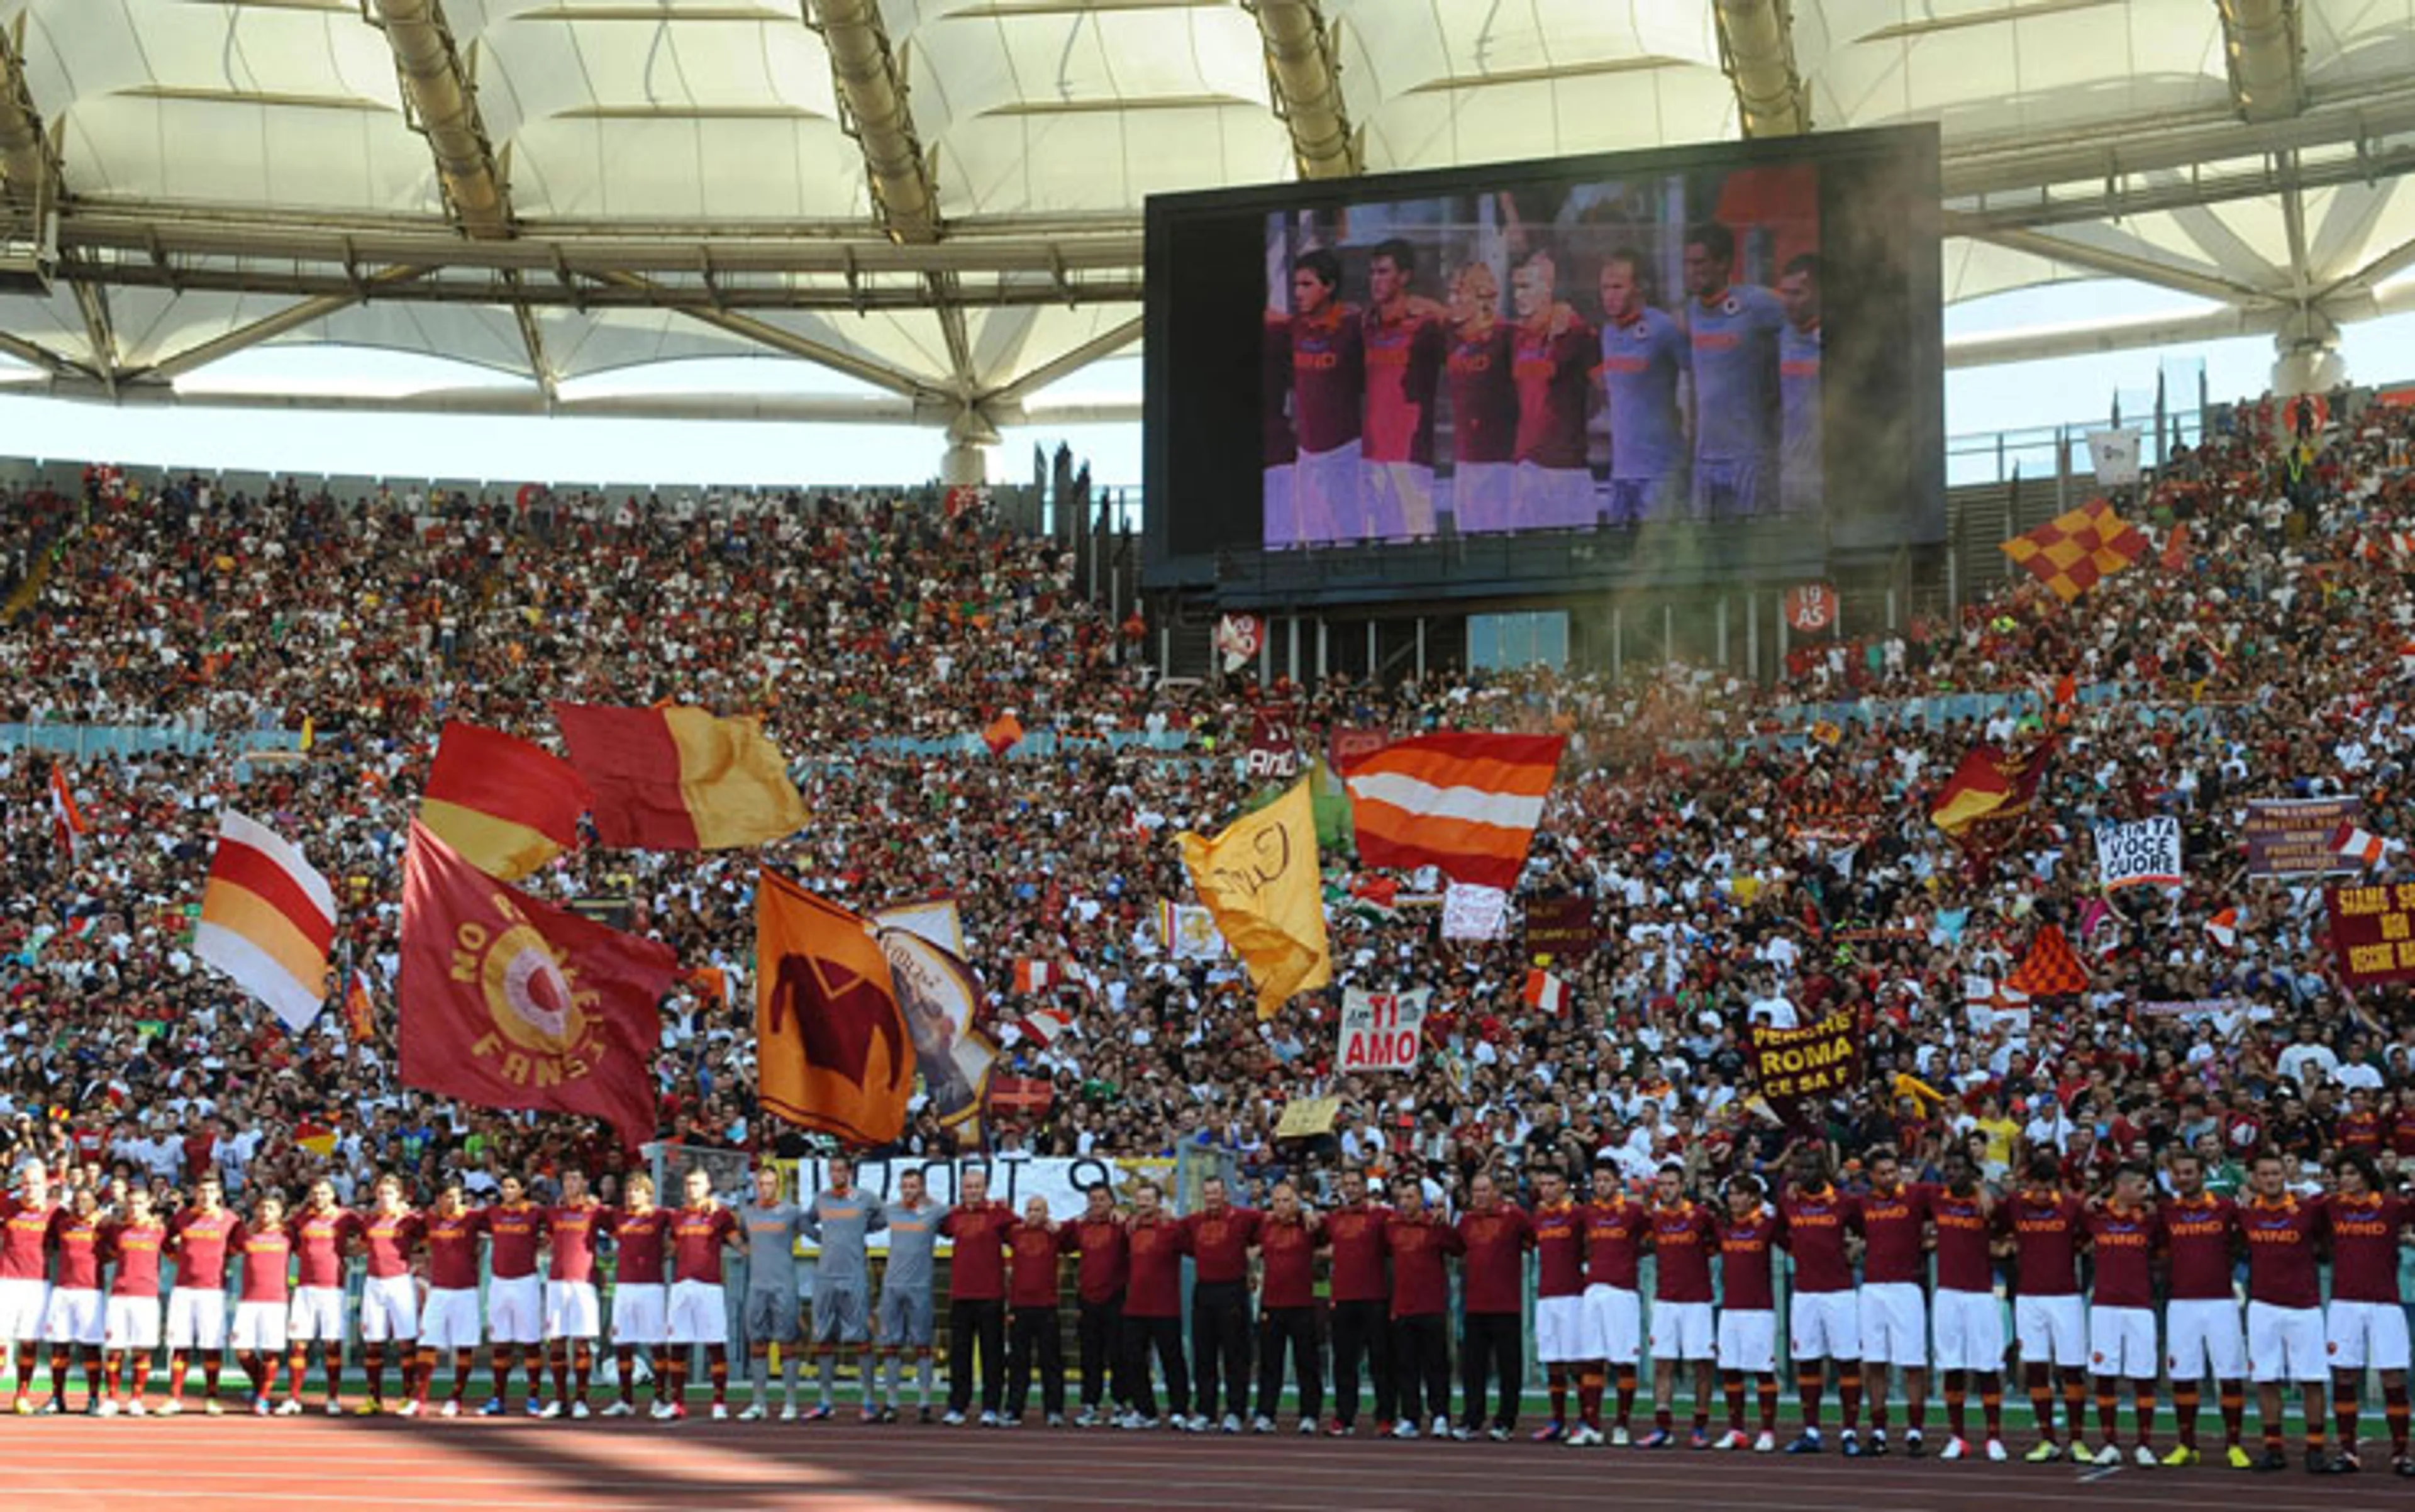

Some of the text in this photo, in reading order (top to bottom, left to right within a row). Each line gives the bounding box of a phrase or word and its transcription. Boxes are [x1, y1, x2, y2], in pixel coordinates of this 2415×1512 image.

[2110, 837, 2168, 858] VOCE
[2107, 855, 2175, 879] CUORE
[1367, 994, 1398, 1029] TI
[1345, 1030, 1416, 1066] AMO
[1760, 1036, 1853, 1075] ROMA
[2248, 1228, 2302, 1243] WIND
[2333, 1221, 2388, 1237] WIND
